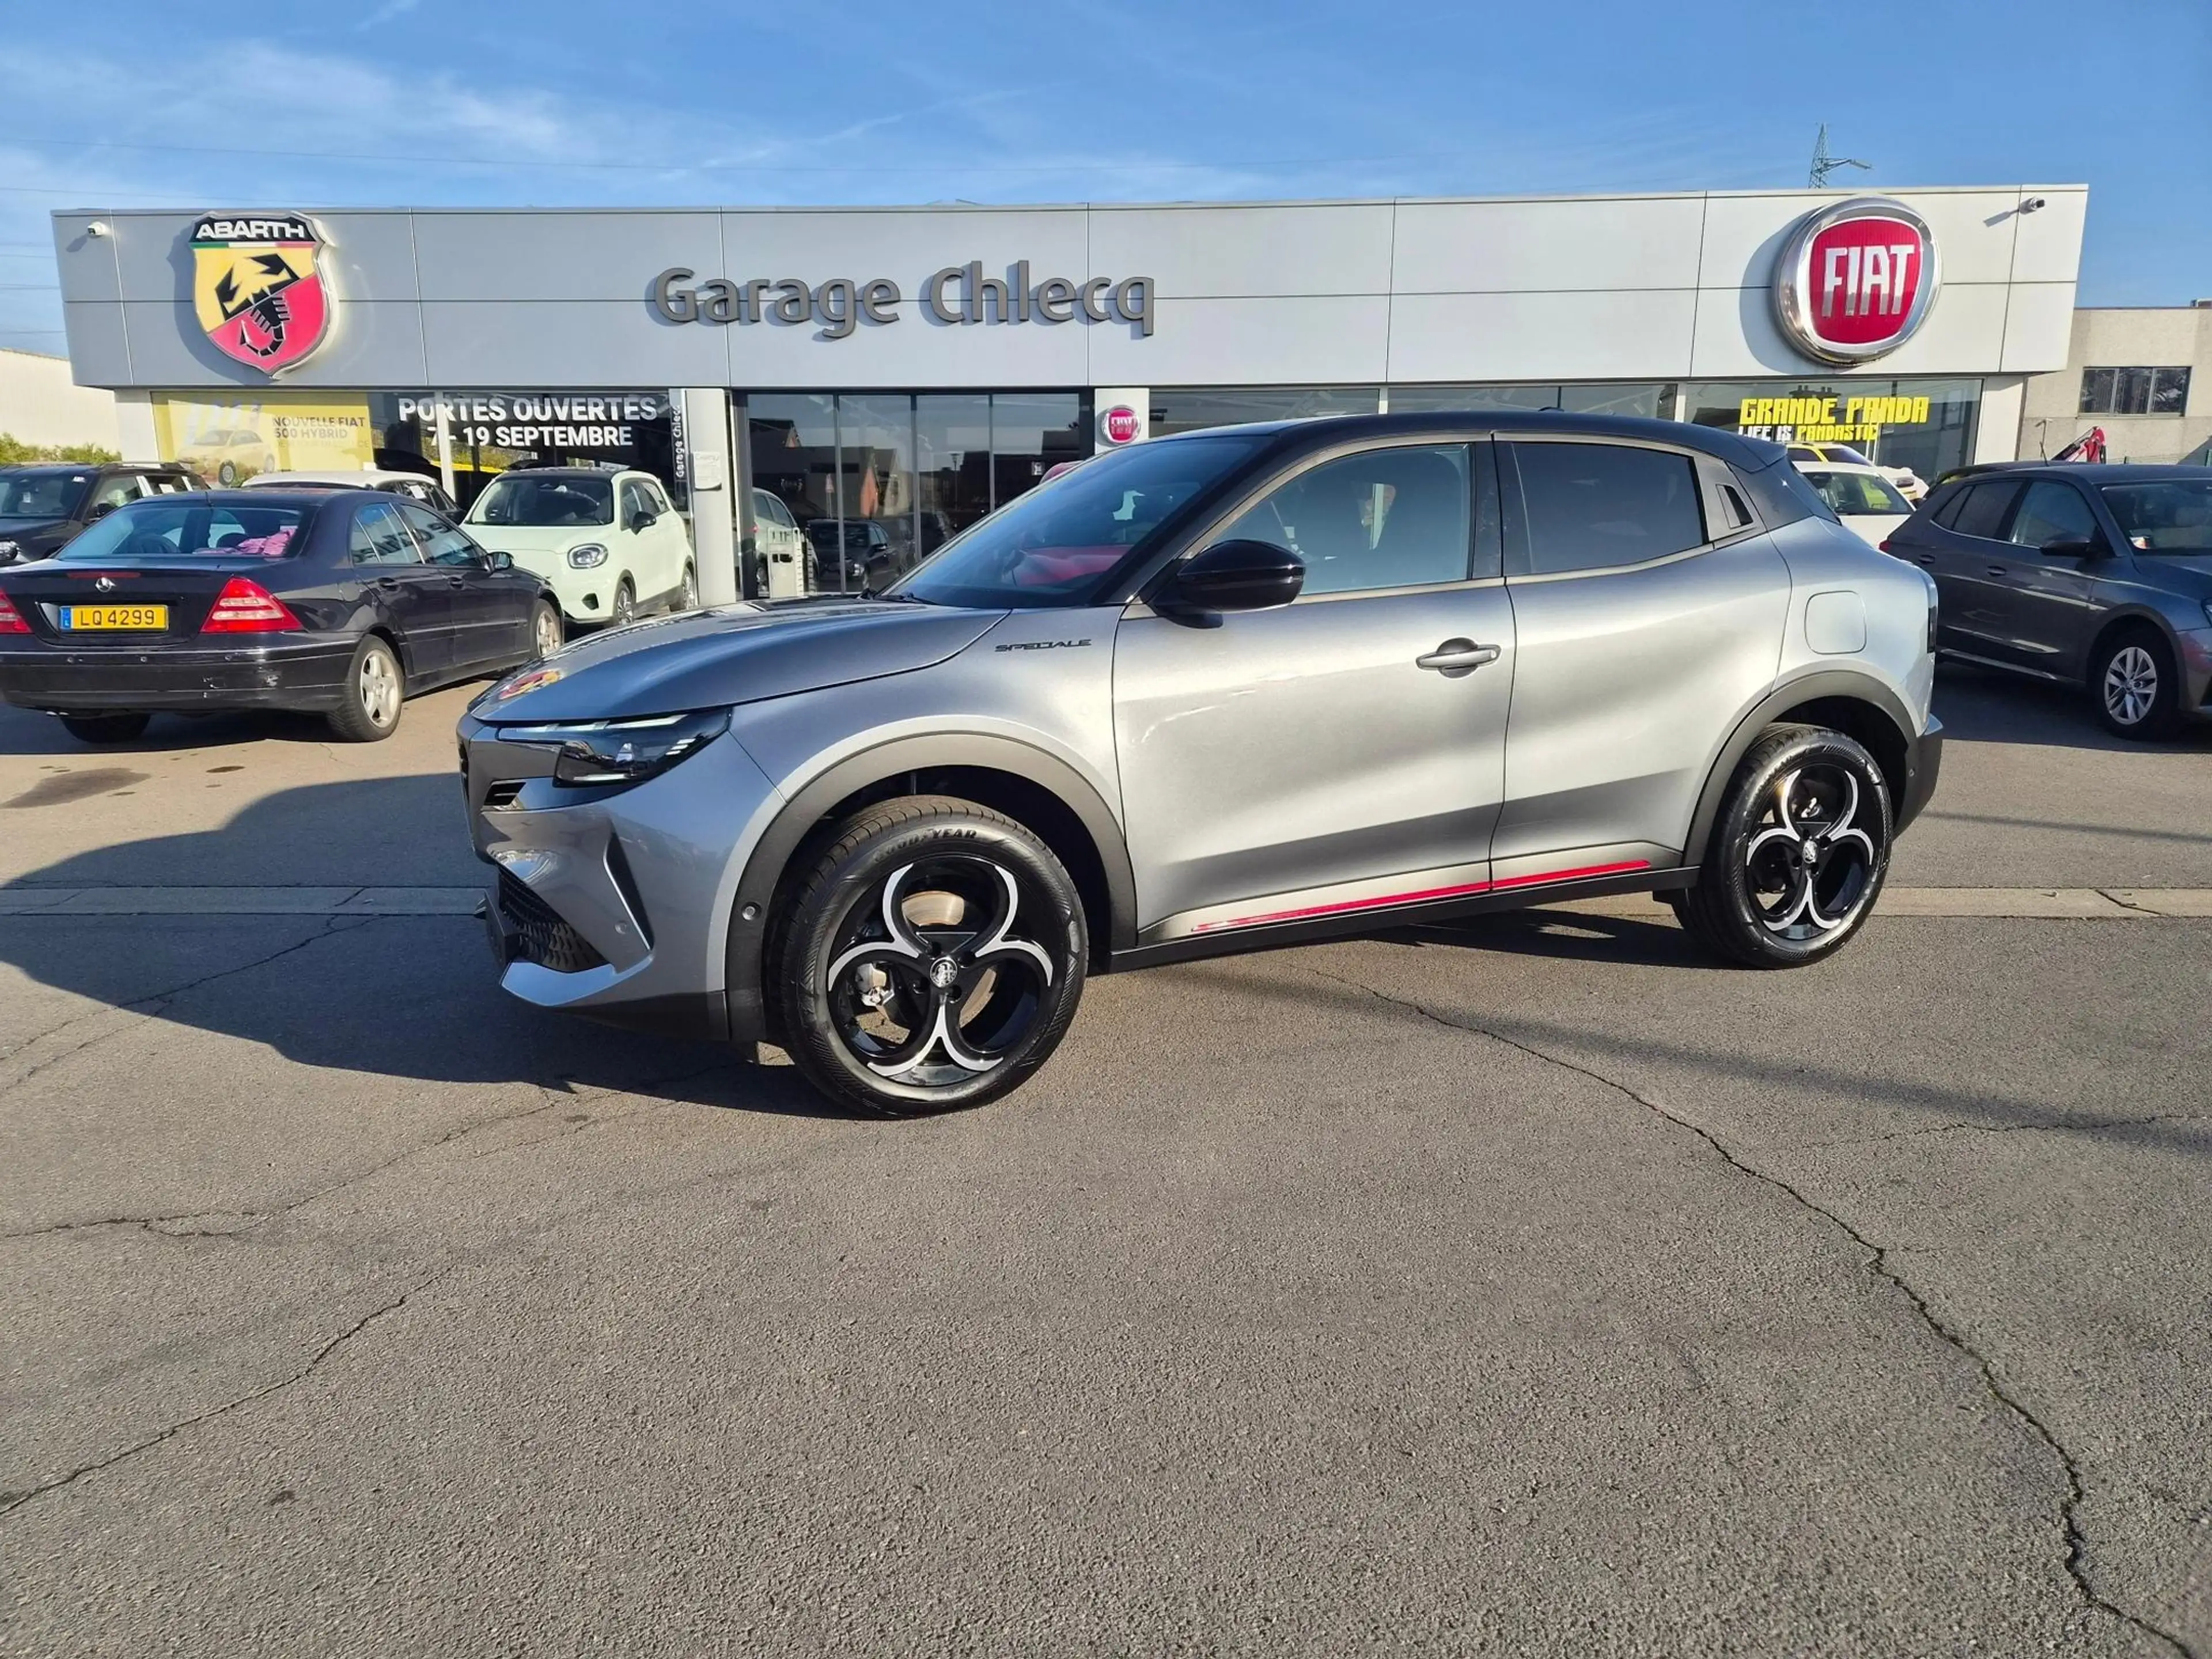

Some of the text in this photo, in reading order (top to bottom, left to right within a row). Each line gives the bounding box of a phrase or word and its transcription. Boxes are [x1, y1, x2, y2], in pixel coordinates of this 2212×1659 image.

[196, 221, 304, 238] ABARTH
[1822, 244, 1915, 317] FIAT
[654, 260, 1154, 338] Garage Chlecq
[398, 397, 658, 422] PORTES OUVERTES
[1740, 397, 1930, 425] GRANDE PANDA
[274, 416, 366, 427] NOUVELLE FIAT
[275, 428, 348, 439] 500 HYBRID
[463, 426, 490, 447] 19
[495, 426, 633, 447] SEPTEMBRE
[1738, 425, 1880, 442] LIFE IS PANDASTIC
[676, 440, 685, 478] Garage
[107, 609, 154, 626] 4299
[994, 639, 1092, 653] SPECIALE
